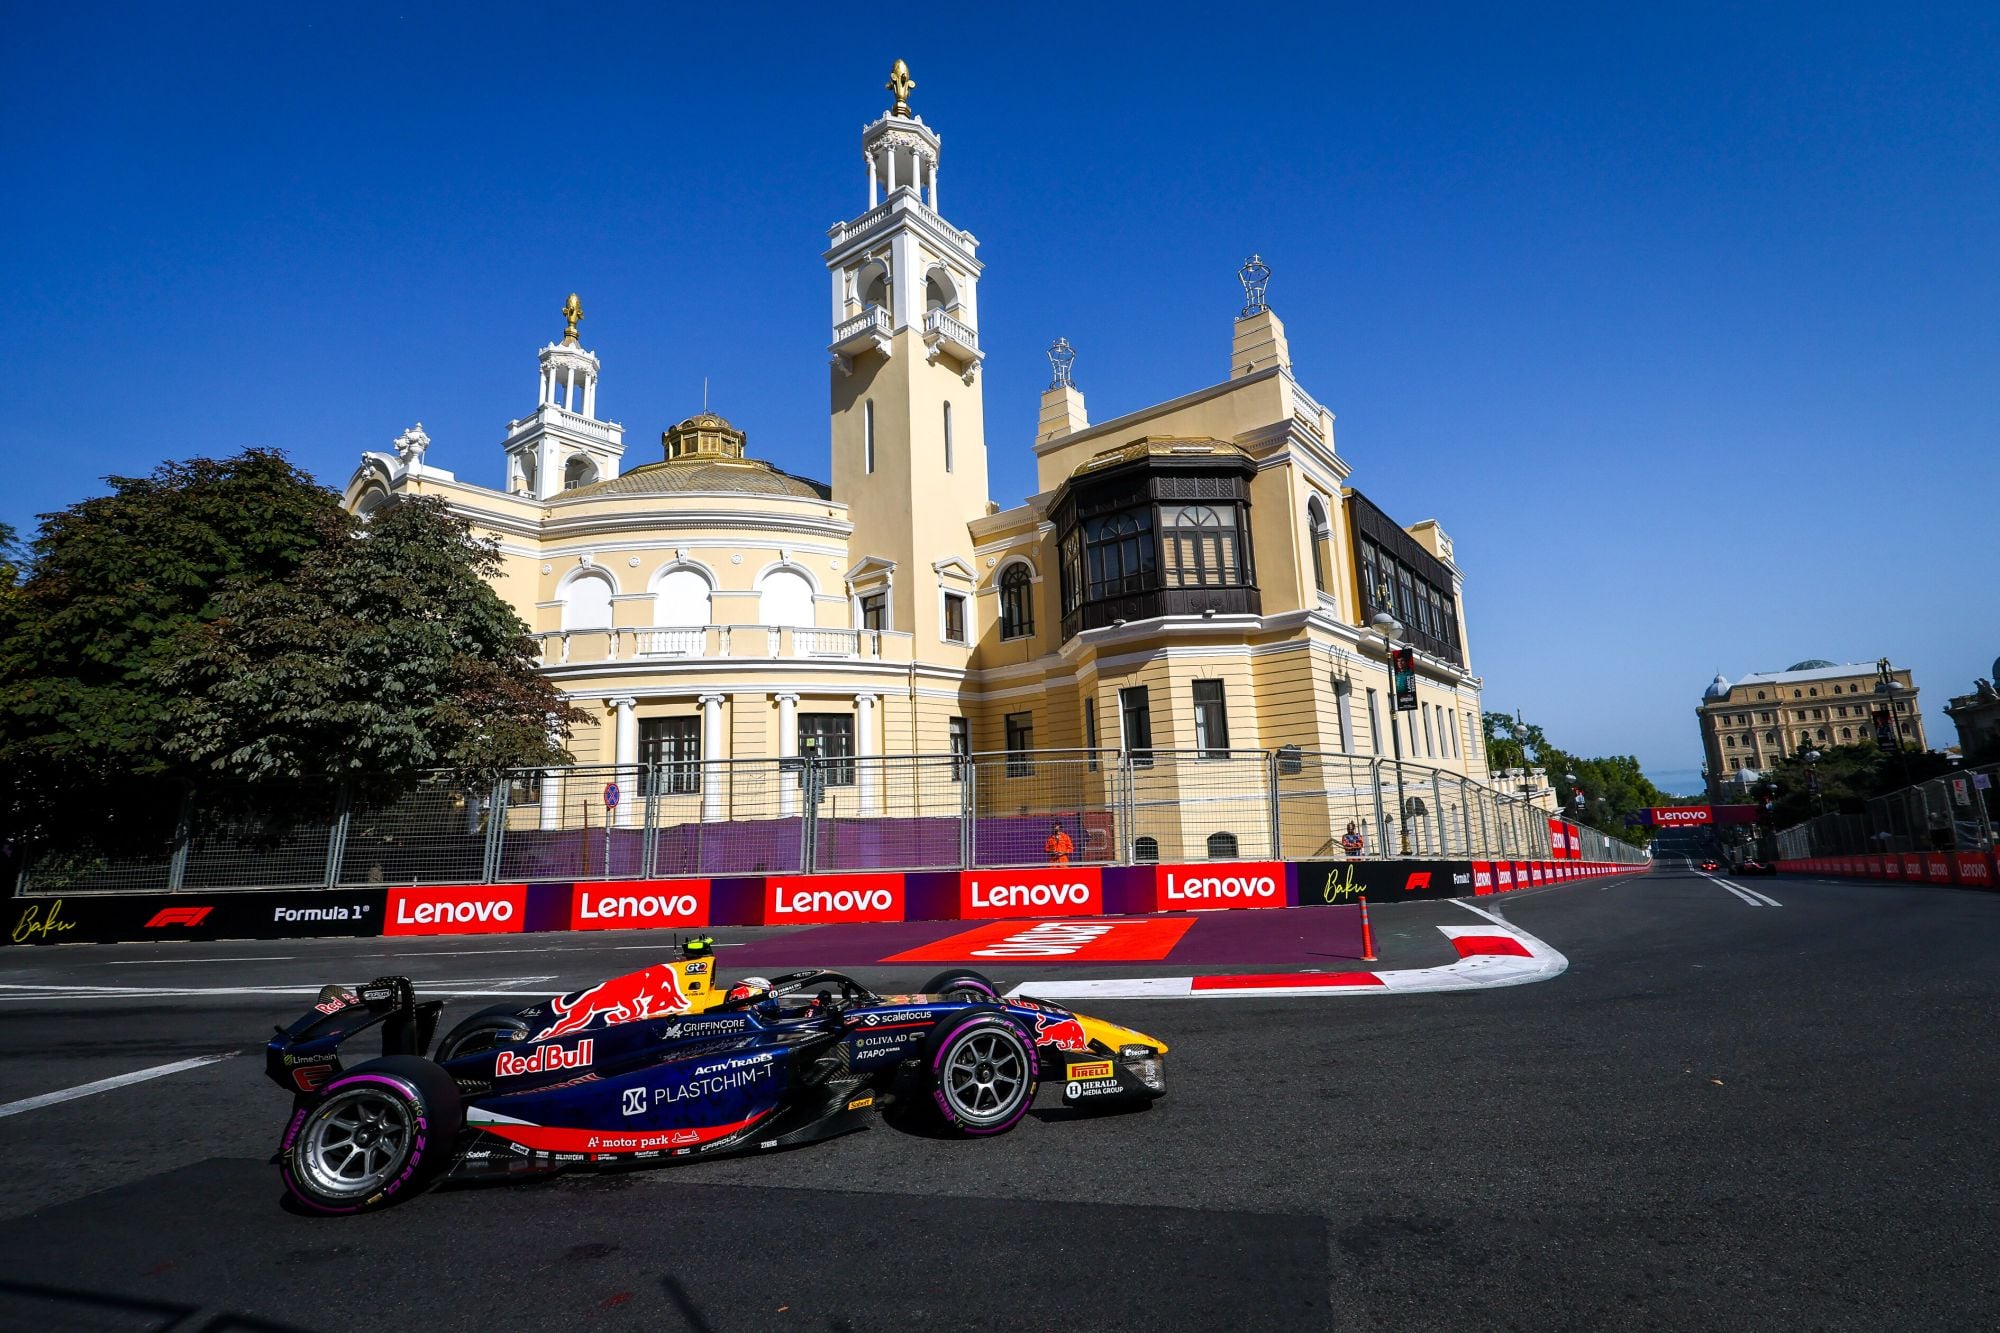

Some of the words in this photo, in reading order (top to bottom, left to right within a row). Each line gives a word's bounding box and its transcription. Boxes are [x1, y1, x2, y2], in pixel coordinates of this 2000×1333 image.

[1656, 810, 1707, 821] Lenovo
[1958, 859, 1987, 878] Lenovo
[1167, 874, 1275, 899] Lenovo
[1323, 864, 1367, 902] Baku
[775, 887, 892, 913] Lenovo
[971, 881, 1089, 908] Lenovo
[397, 898, 513, 924] Lenovo
[580, 893, 697, 918] Lenovo
[274, 907, 348, 921] Formula
[881, 1010, 932, 1023] scalefocus
[865, 1035, 893, 1046] OLIVA
[894, 1034, 907, 1043] AD
[293, 1053, 337, 1064] LimeChain
[496, 1045, 545, 1077] Red
[544, 1039, 594, 1071] Bull
[856, 1048, 886, 1060] ATAPO
[1072, 1063, 1109, 1078] PIRELLI
[654, 1062, 774, 1105] PLASTCHIM-T
[1082, 1080, 1118, 1090] HERALD
[1082, 1089, 1102, 1097] MEDIA
[1102, 1086, 1124, 1095] GROUP
[602, 1138, 638, 1148] motor
[641, 1135, 669, 1149] park
